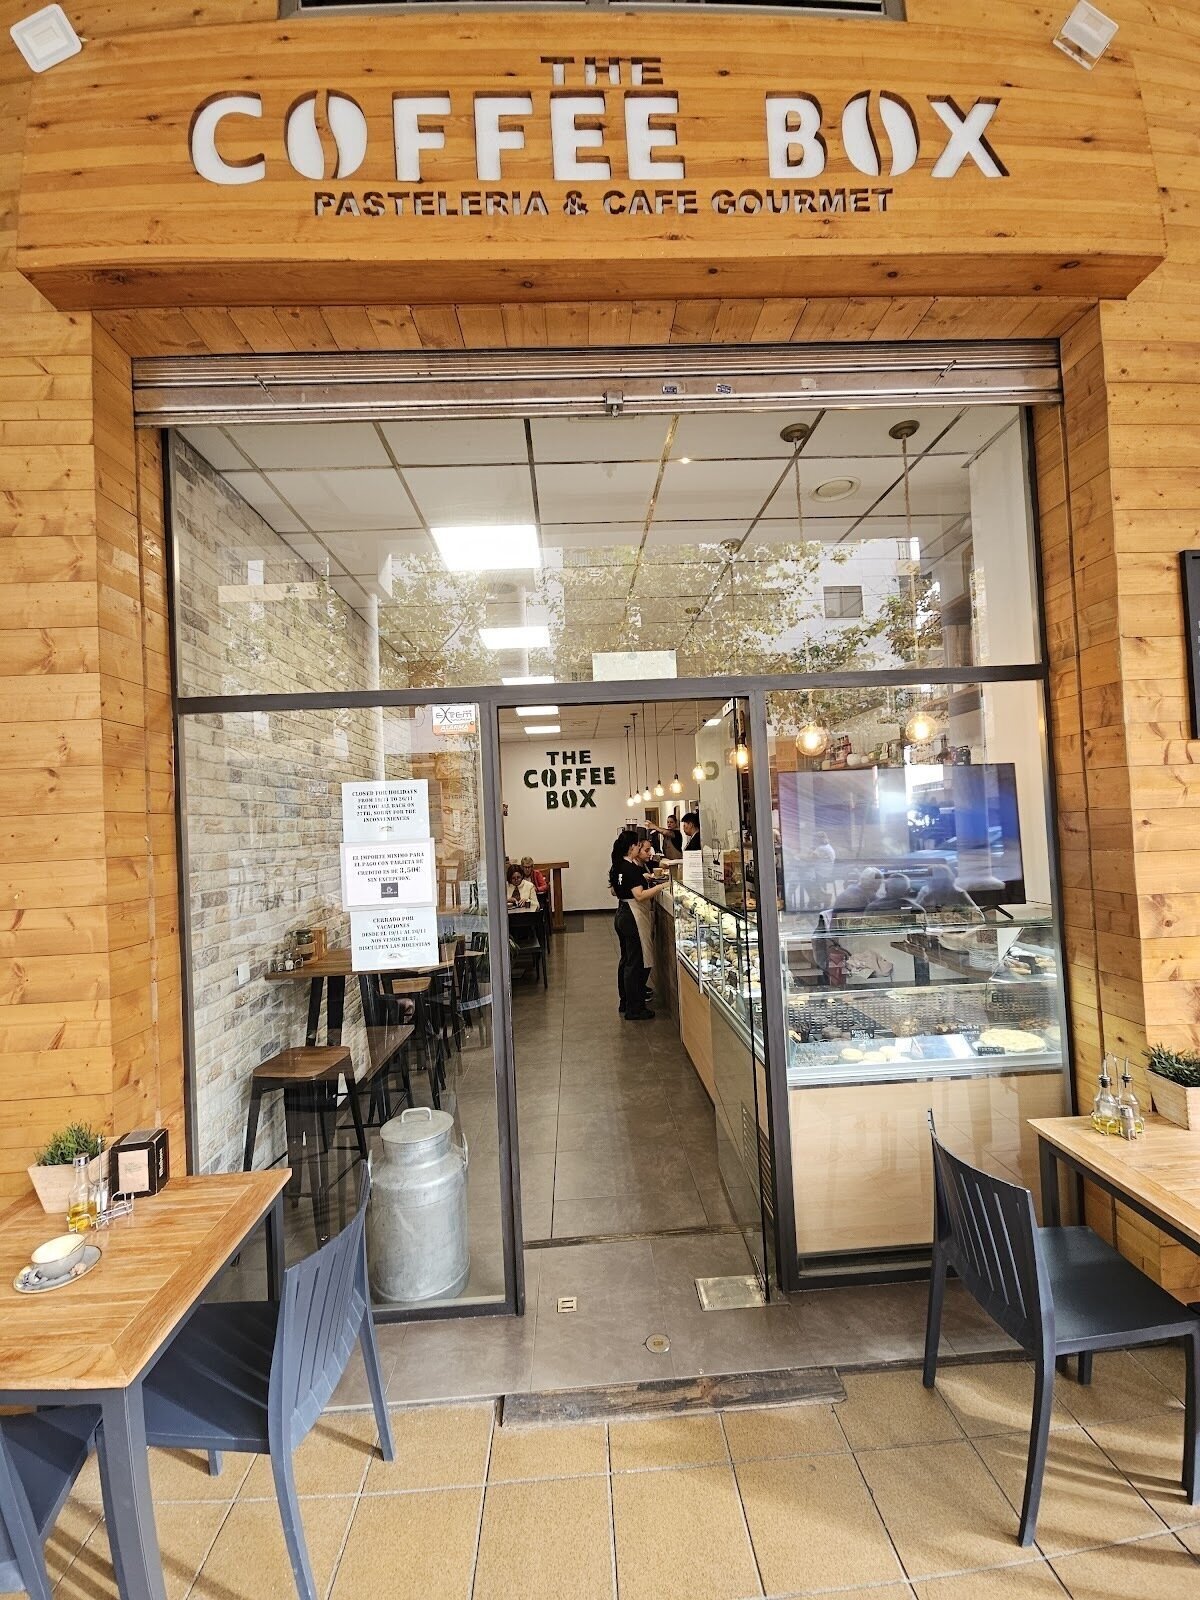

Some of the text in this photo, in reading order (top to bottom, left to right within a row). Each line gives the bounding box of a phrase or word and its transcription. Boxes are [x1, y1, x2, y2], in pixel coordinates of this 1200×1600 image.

[540, 55, 663, 86] THE
[188, 88, 1010, 185] COFFEE BOX
[314, 187, 894, 217] PASTELERIA & CAFE GOURMET
[546, 750, 592, 766] THE
[524, 766, 616, 788] COFFEE
[546, 788, 597, 810] BOX
